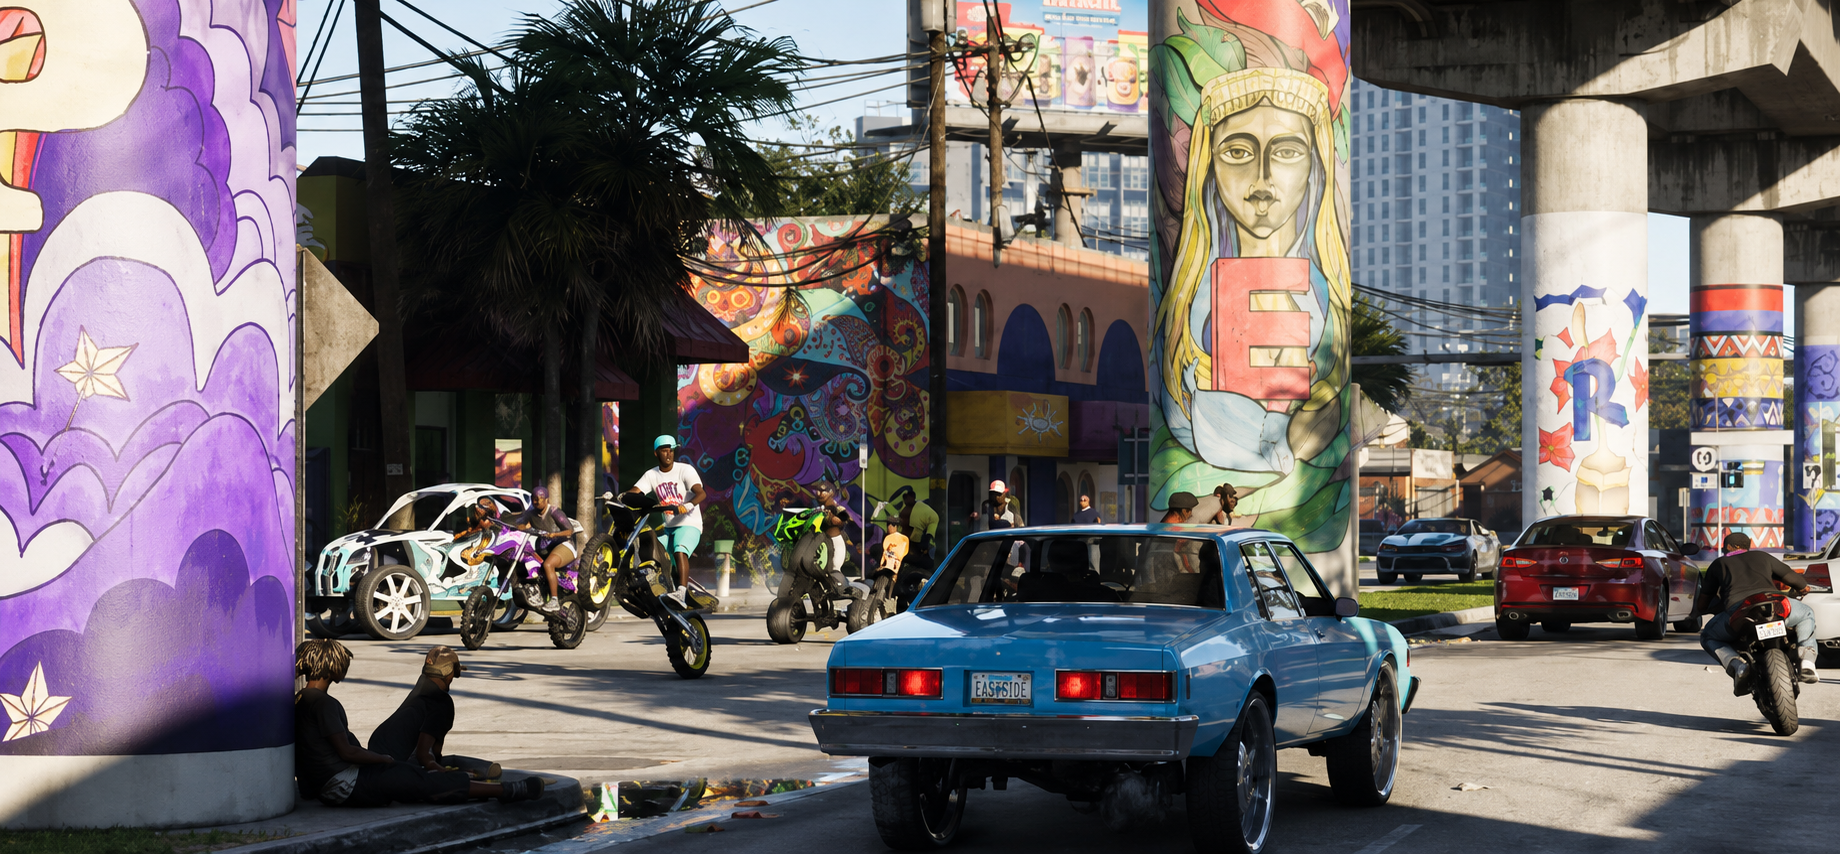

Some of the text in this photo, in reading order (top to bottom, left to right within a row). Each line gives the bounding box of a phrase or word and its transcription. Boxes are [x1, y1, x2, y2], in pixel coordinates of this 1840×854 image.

[1211, 257, 1311, 400] E
[1564, 358, 1629, 441] R
[975, 681, 1027, 698] EASTSIDE
